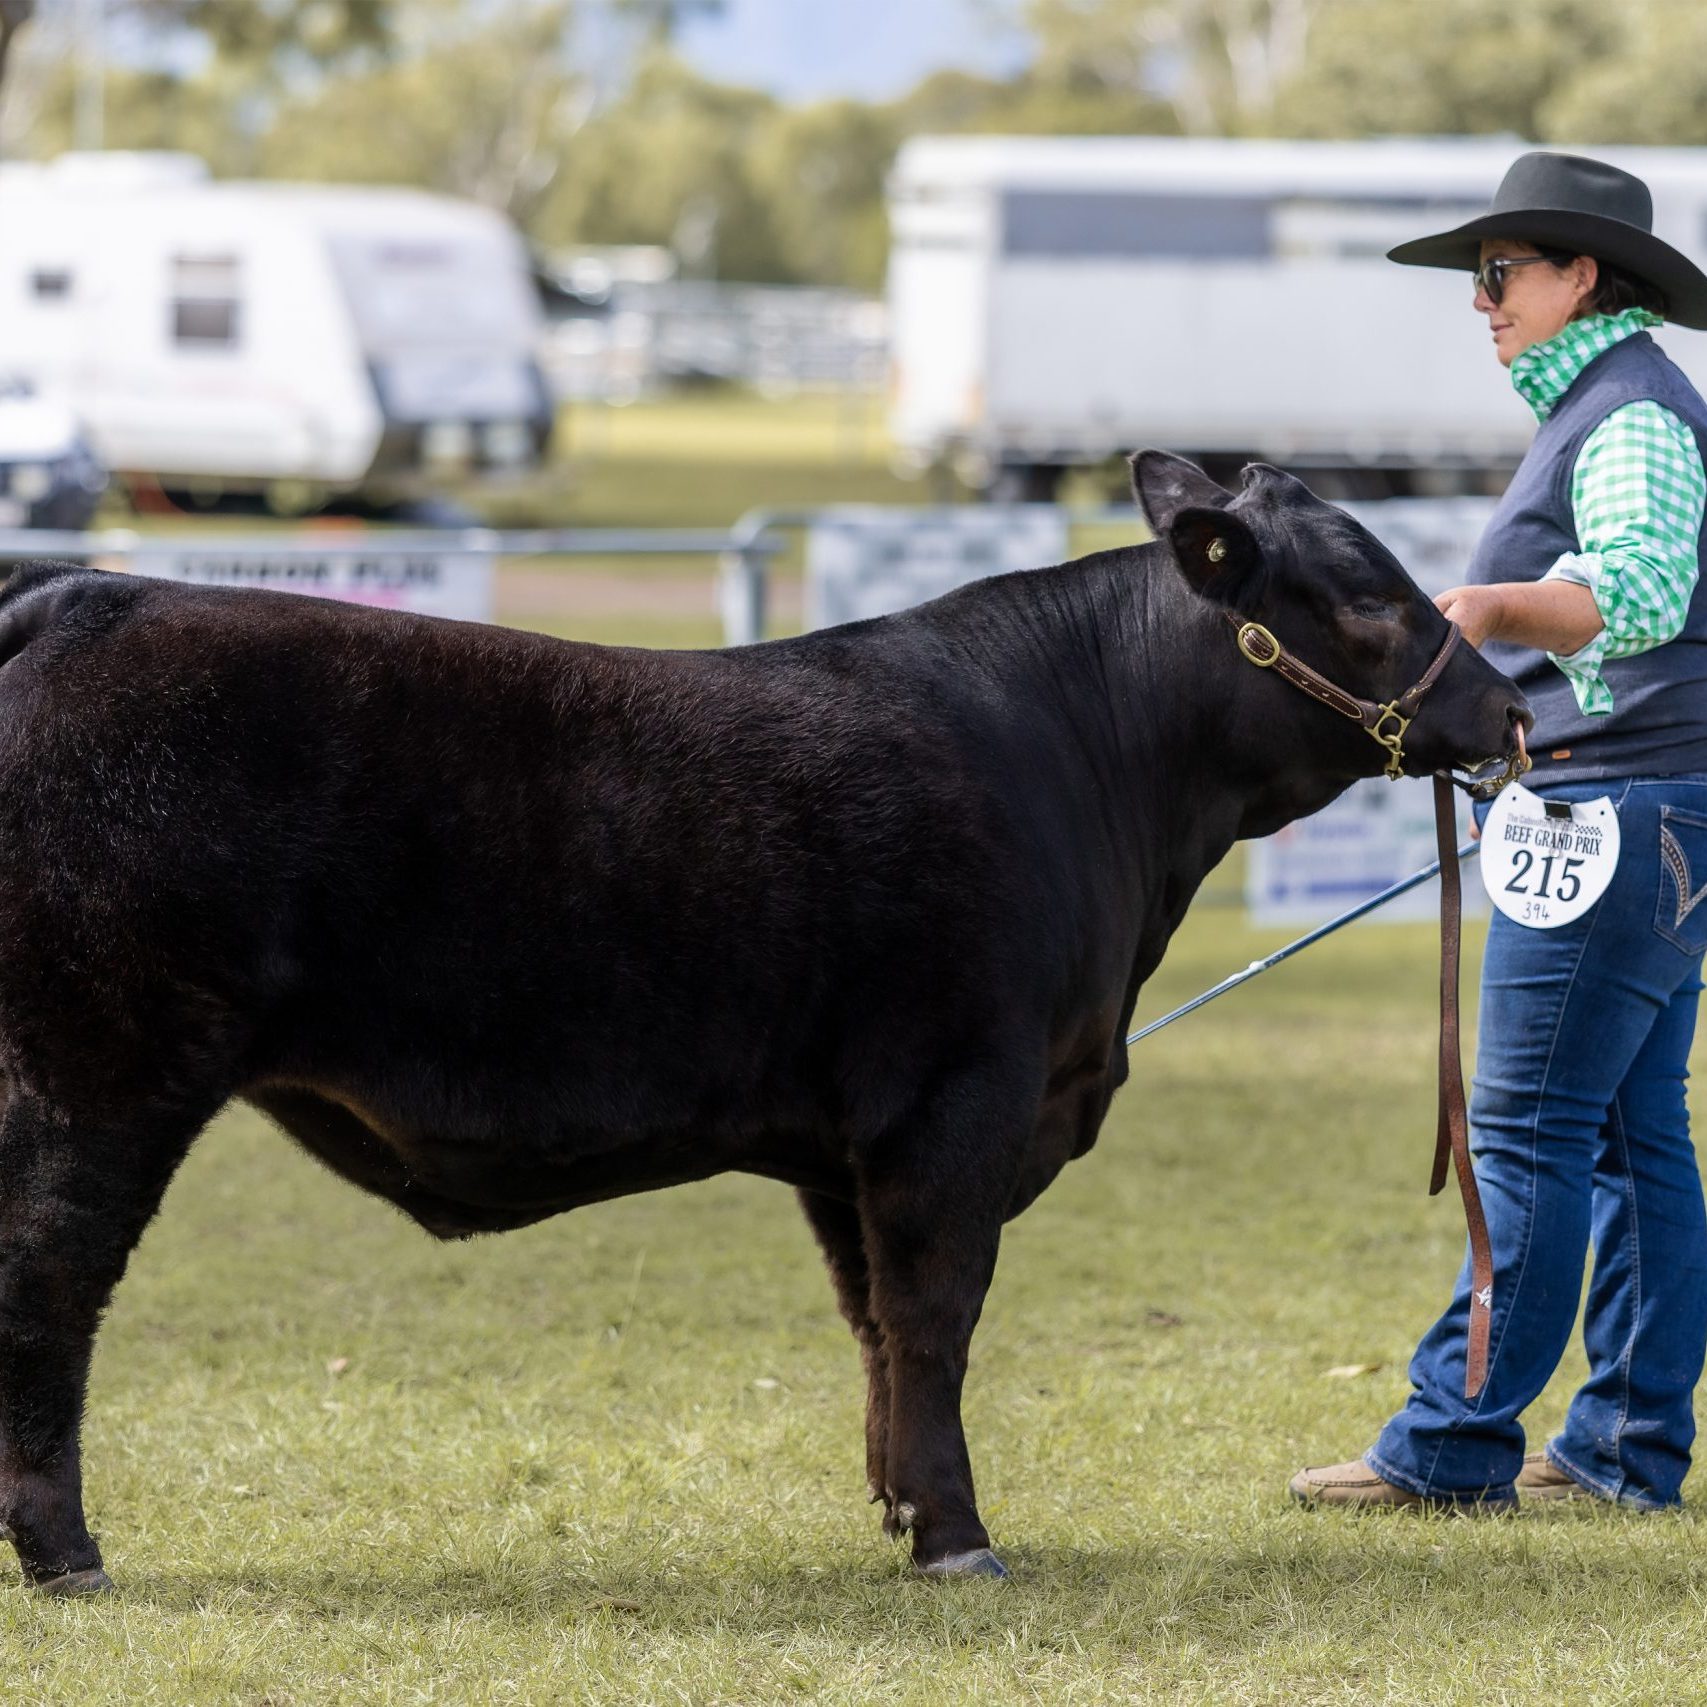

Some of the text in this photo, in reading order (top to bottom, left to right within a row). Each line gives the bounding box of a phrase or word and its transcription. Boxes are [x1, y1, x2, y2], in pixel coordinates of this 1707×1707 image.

[1504, 824, 1533, 844] BEEF
[1534, 828, 1573, 851] GRAND
[1574, 835, 1603, 856] PRIX
[1504, 849, 1586, 902] 215
[1521, 901, 1550, 921] 394
